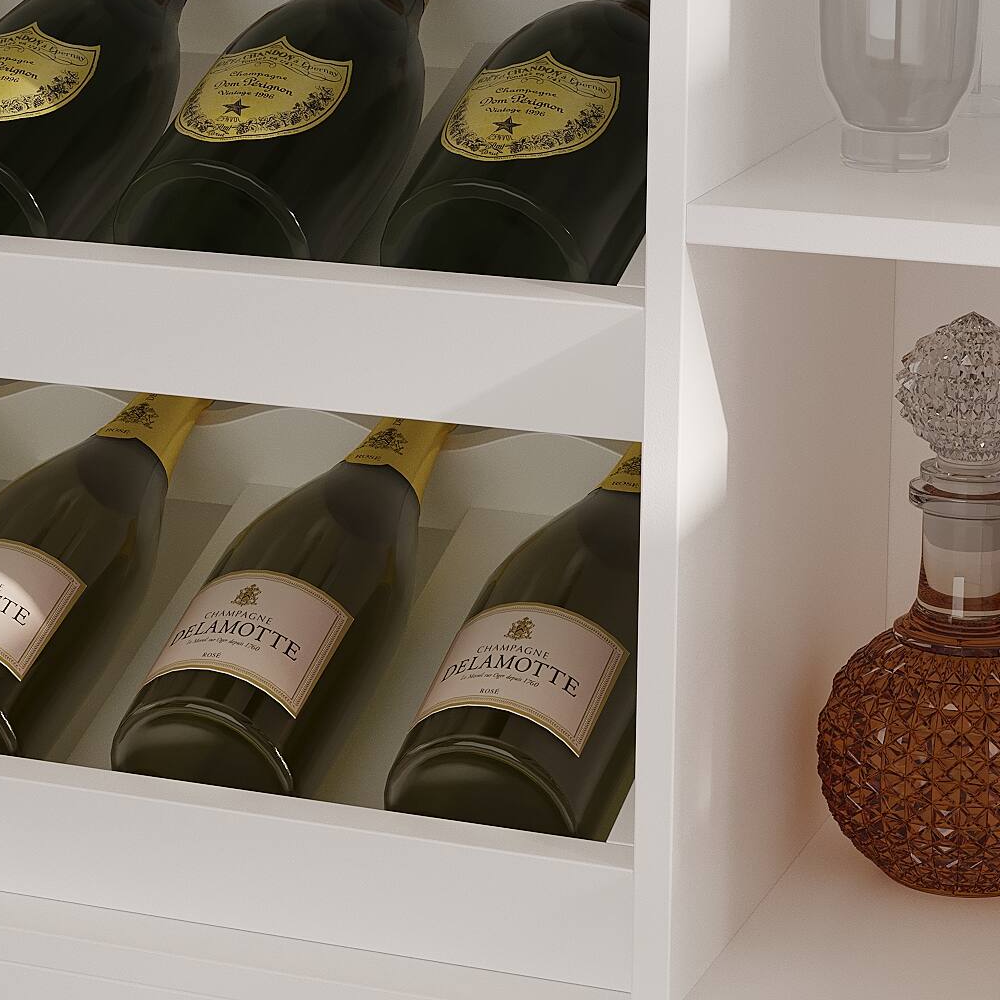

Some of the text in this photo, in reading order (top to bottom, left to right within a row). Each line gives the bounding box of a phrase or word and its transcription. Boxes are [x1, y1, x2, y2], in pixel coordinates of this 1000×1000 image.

[229, 69, 288, 81] Champagne
[243, 76, 294, 96] Pérignon
[494, 86, 557, 98] Champagne
[479, 93, 565, 114] Dom Pérignon
[204, 609, 273, 625] CHAMPAGNE
[169, 619, 301, 662] DELAMOTTE
[476, 644, 550, 660] CHAMPAGNE
[440, 654, 581, 698] DELAMOTTE
